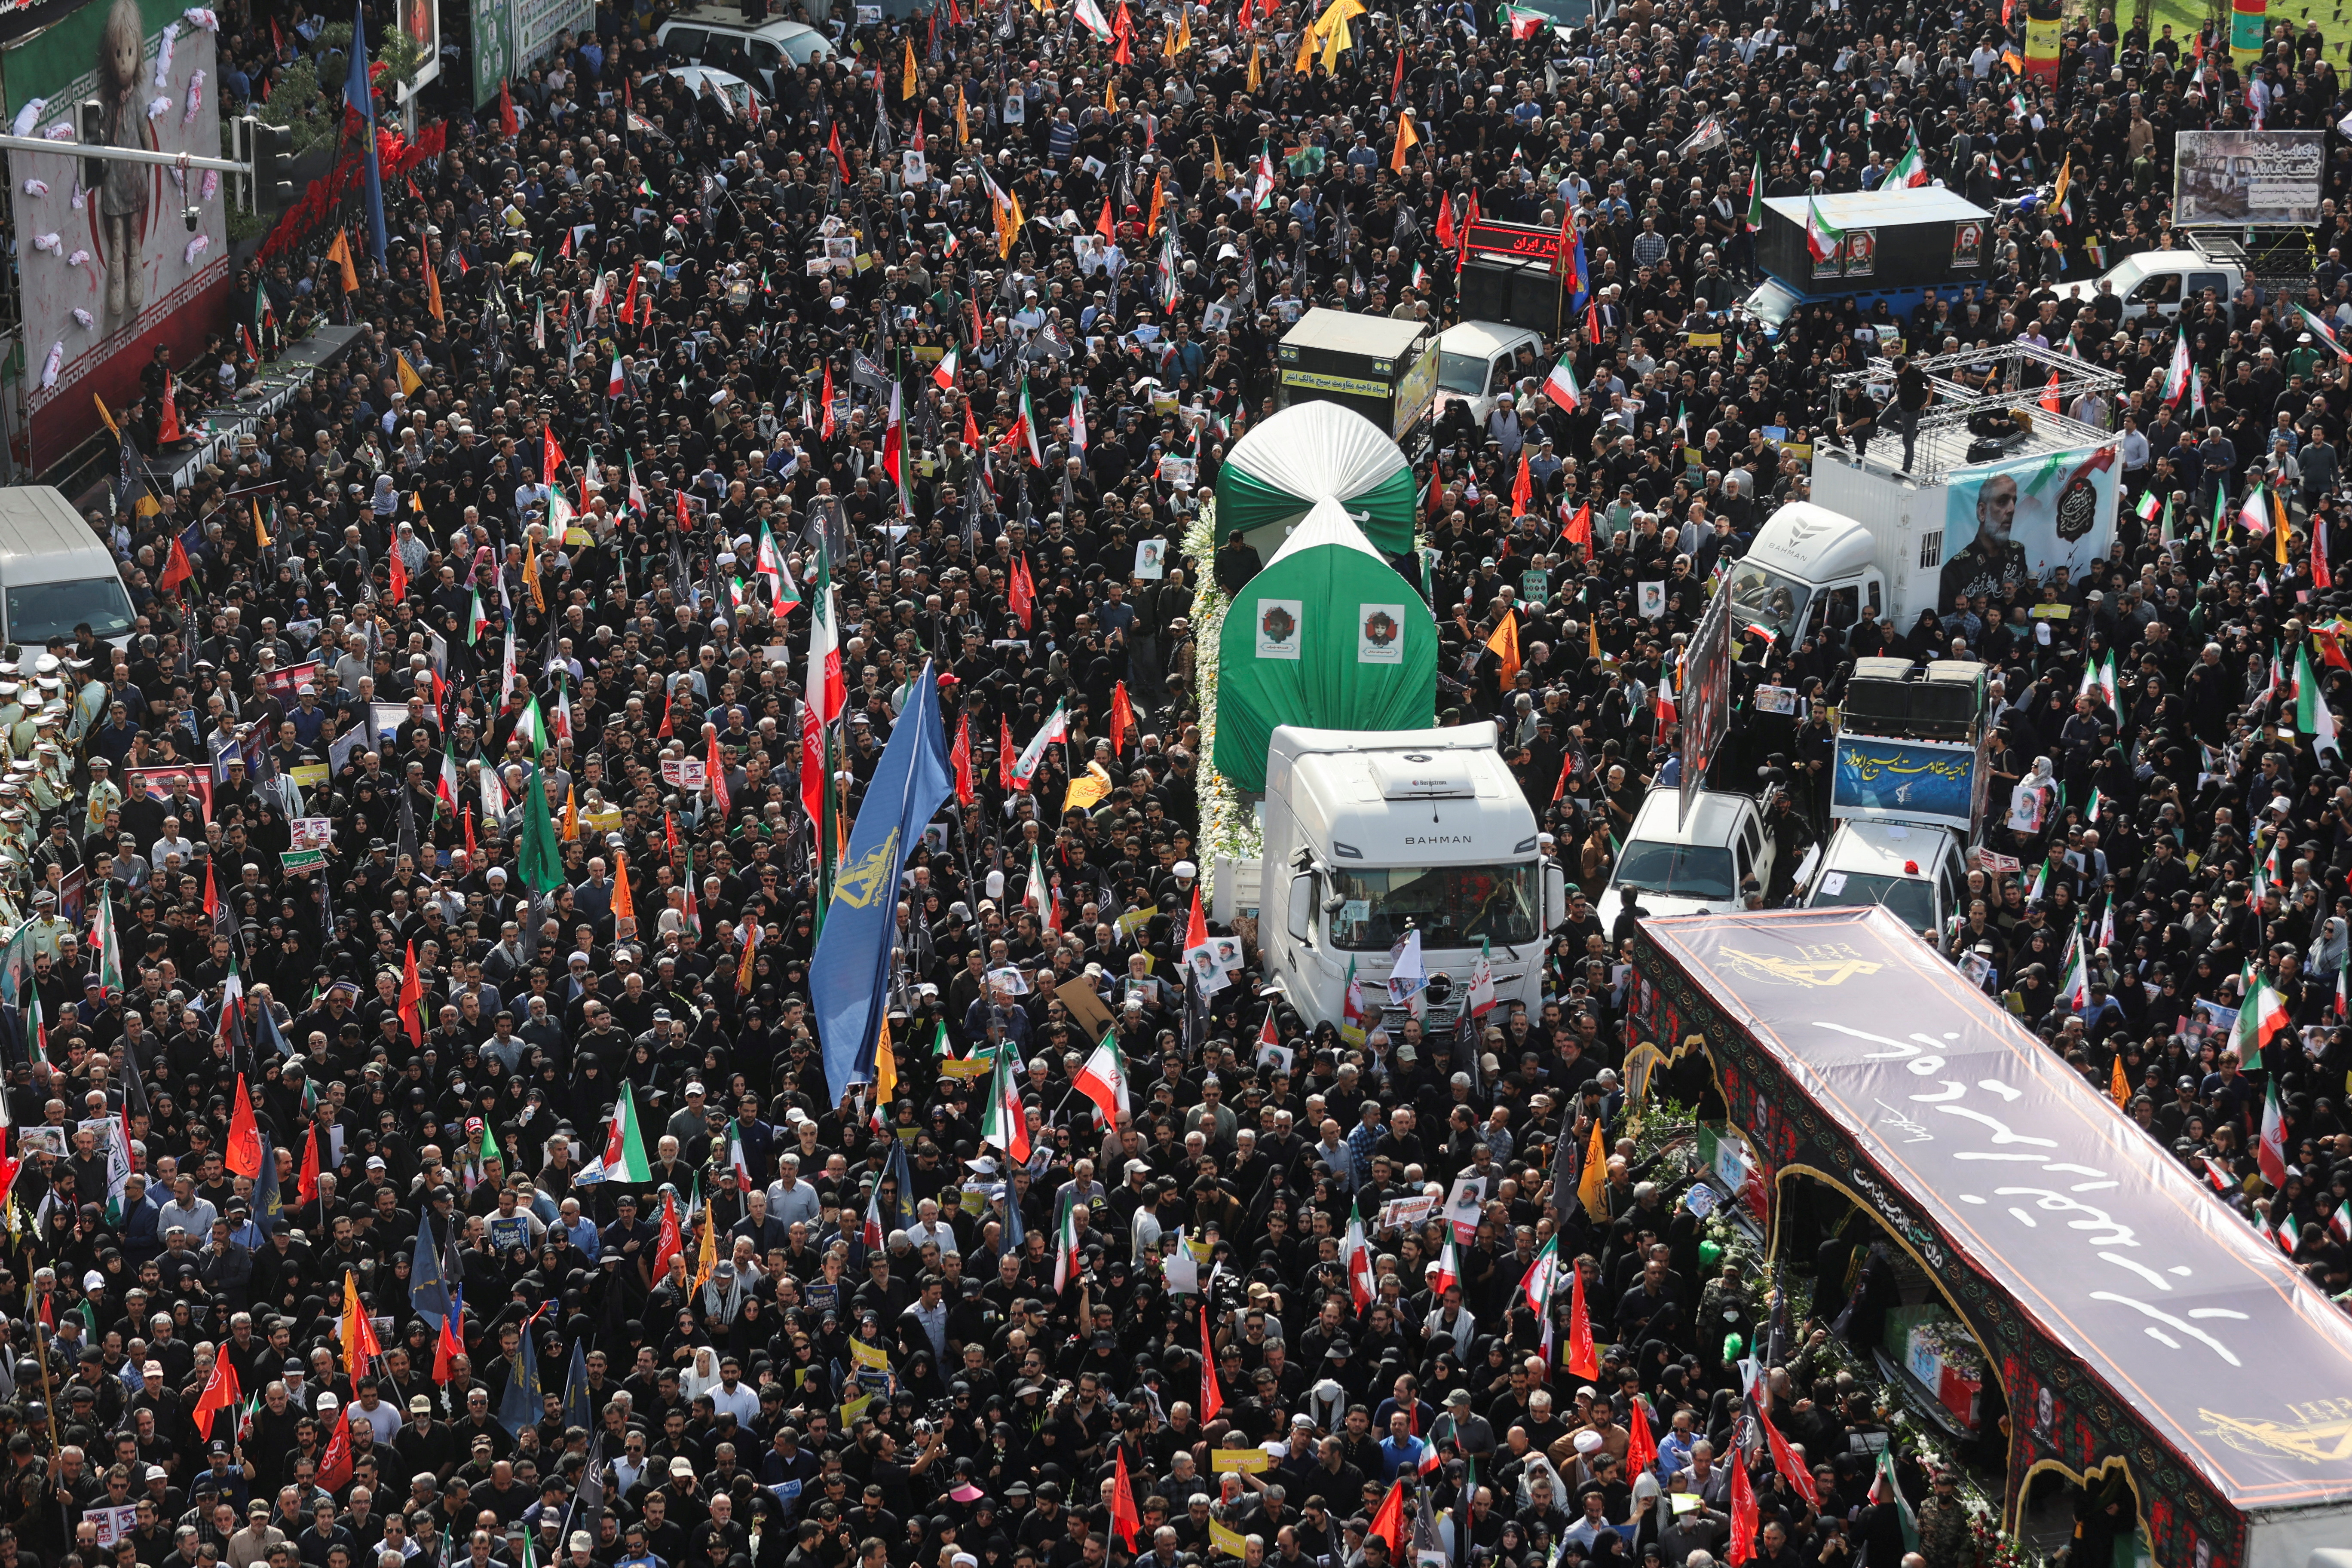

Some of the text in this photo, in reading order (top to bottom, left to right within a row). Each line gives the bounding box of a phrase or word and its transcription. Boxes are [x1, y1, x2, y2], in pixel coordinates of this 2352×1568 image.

[2251, 161, 2320, 178] کشته شدند
[1514, 236, 1539, 251] ایران
[1284, 372, 1386, 395] سپاه ناحیه مقاومت بسیج مالک اشتر
[1768, 542, 1807, 562] BAHMAN
[1844, 748, 1969, 781] ناحیه مقاومت بسیج ابوذر
[1405, 836, 1472, 845] BAHMAN
[1470, 961, 1491, 991] شهدای
[1811, 1022, 1960, 1081] سپاه
[1959, 1180, 2192, 1291] انقلاب
[1853, 1168, 1875, 1197] است
[1874, 1184, 1902, 1223] پیروز
[1908, 1225, 1934, 1246] حسین
[1925, 1241, 1943, 1269] ایران
[322, 1435, 340, 1470] حسین
